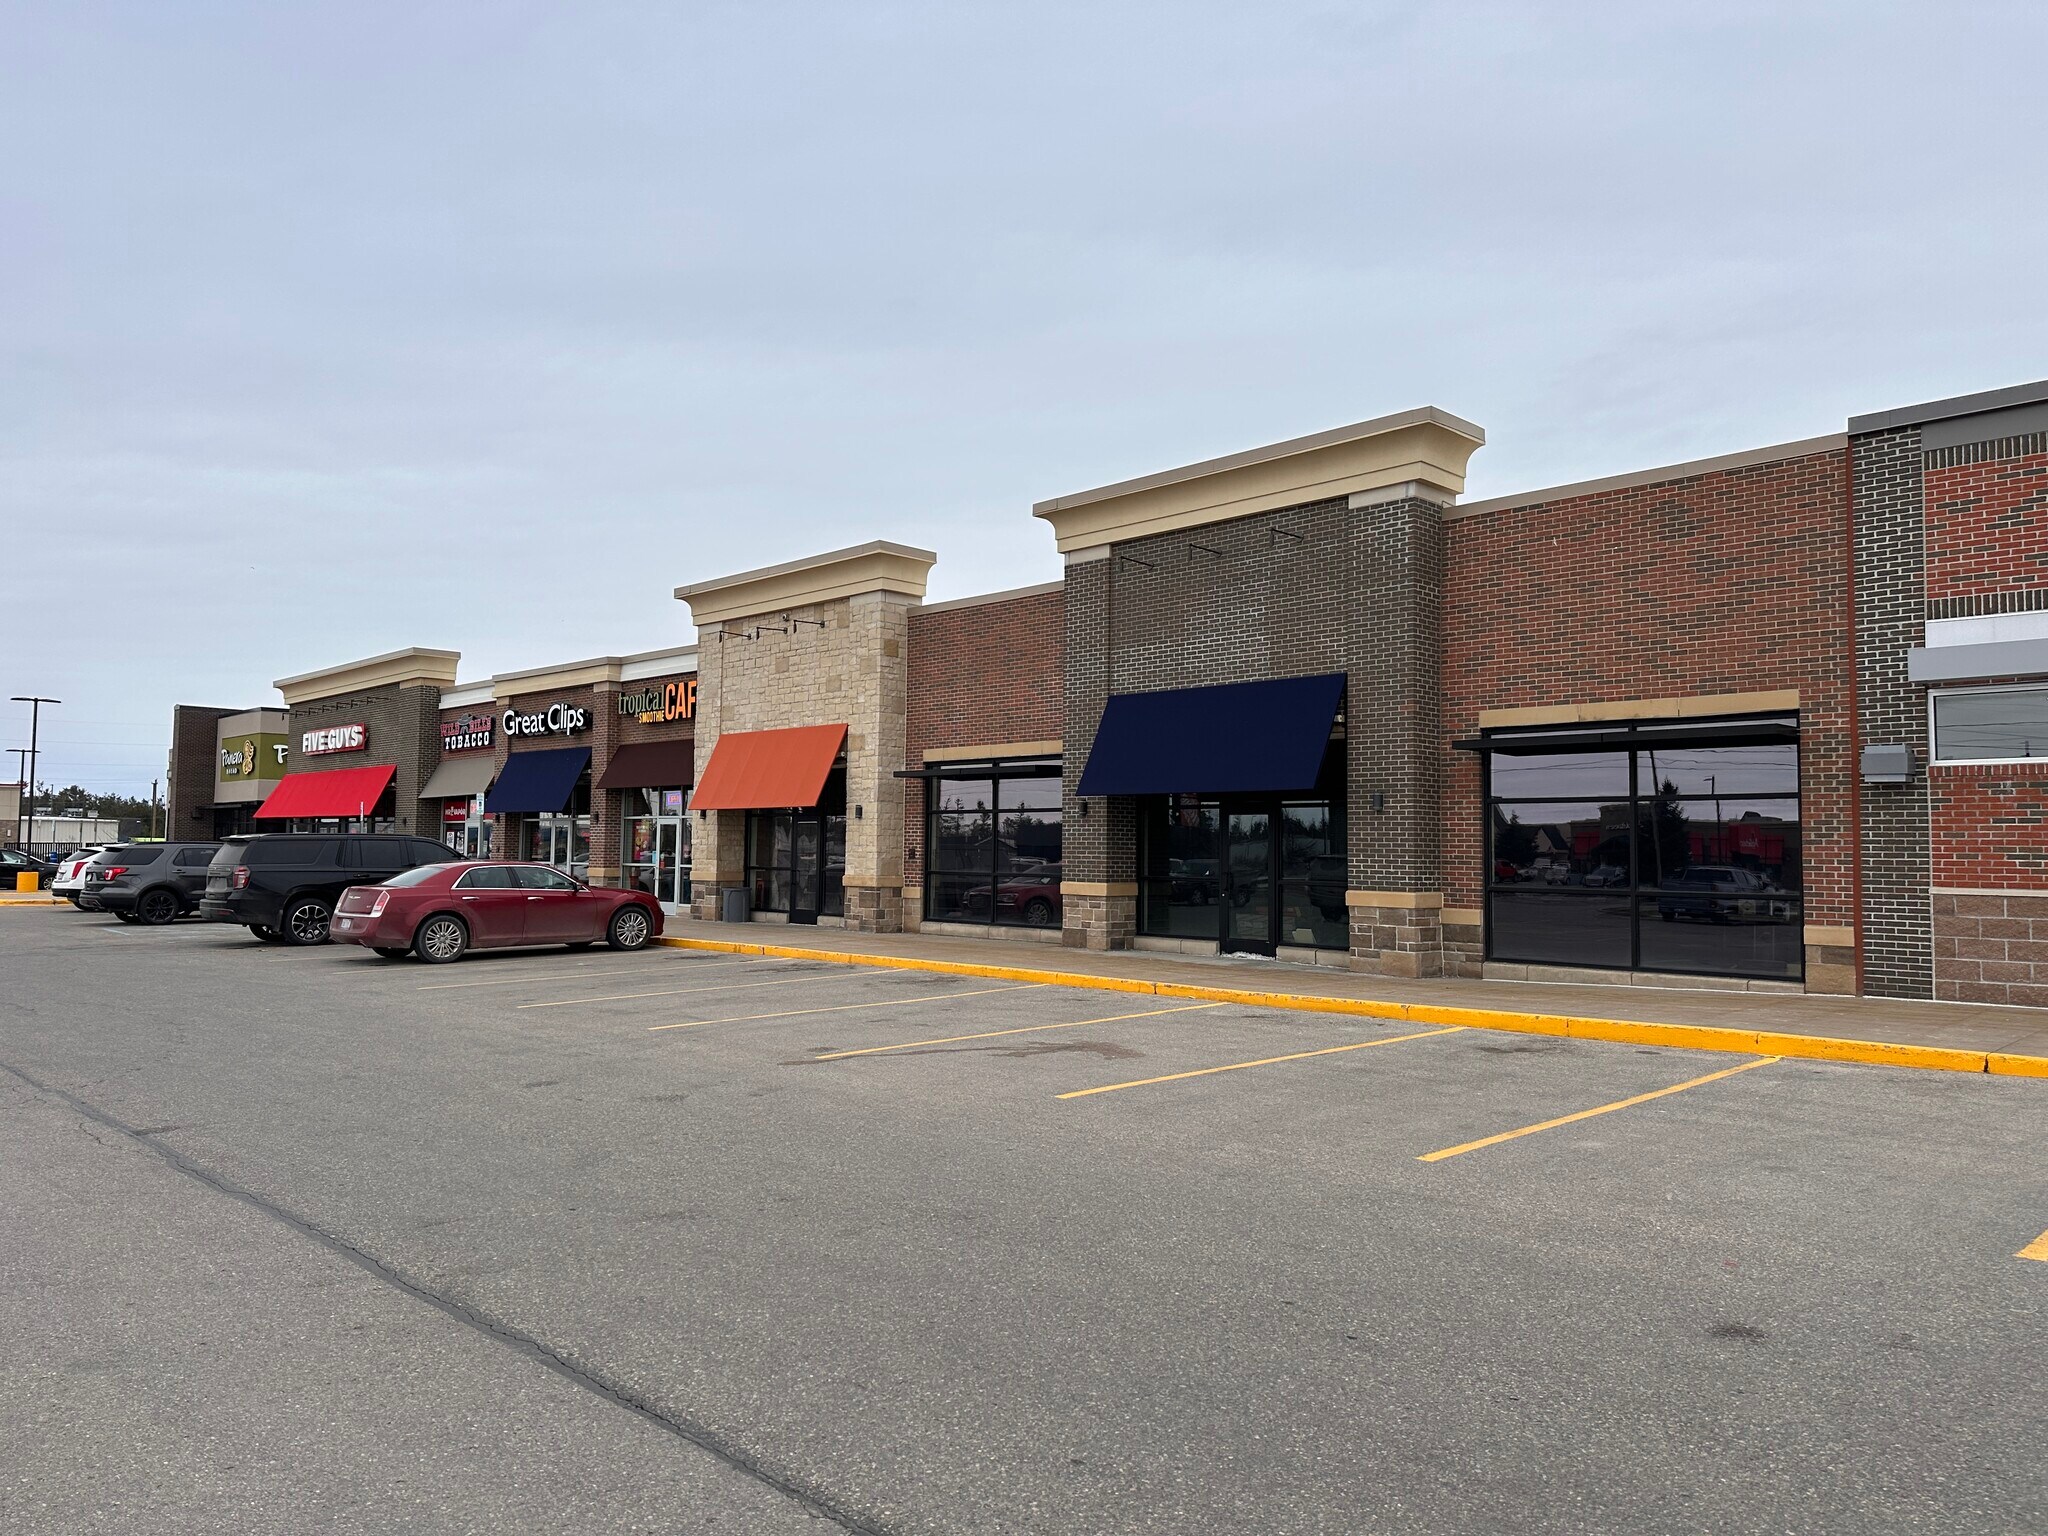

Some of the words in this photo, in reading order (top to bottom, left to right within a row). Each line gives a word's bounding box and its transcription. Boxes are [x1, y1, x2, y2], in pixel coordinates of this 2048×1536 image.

[618, 685, 665, 718] tropical
[502, 709, 545, 736] Great
[547, 703, 584, 736] Clips
[638, 710, 665, 724] SMOOTHIE
[440, 721, 460, 737] WILD
[302, 731, 327, 753] FIVE
[327, 725, 363, 750] GUYS
[445, 731, 490, 750] TOBACCO
[221, 748, 243, 767] Panera
